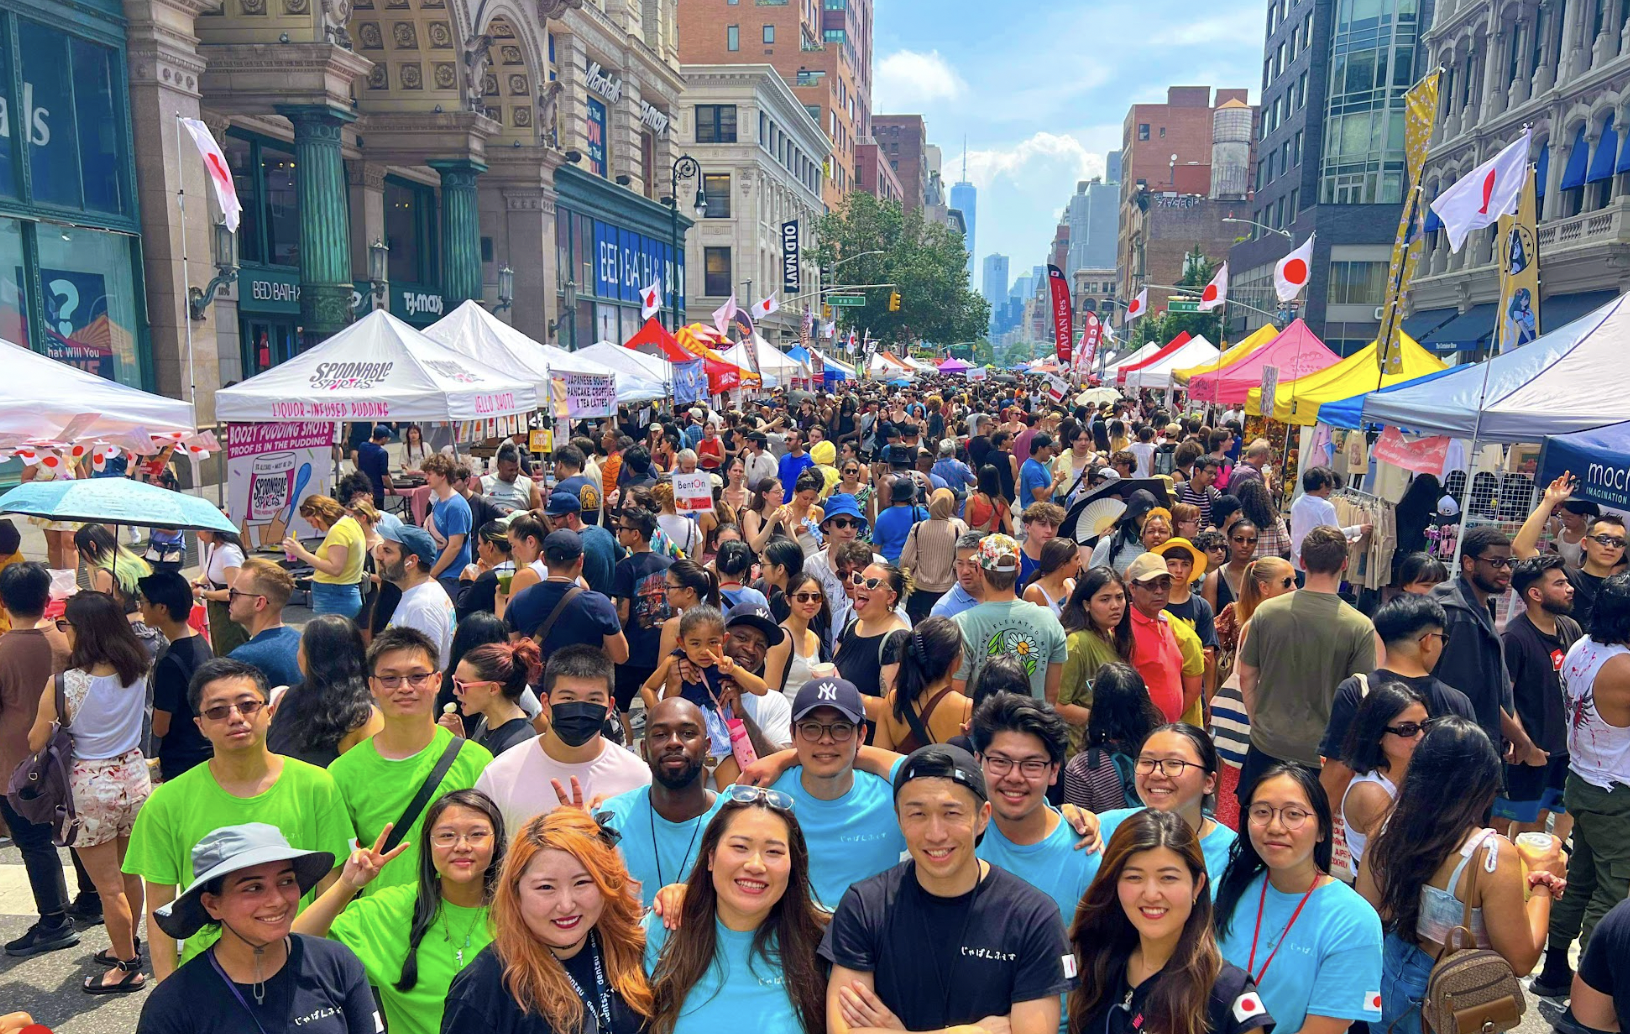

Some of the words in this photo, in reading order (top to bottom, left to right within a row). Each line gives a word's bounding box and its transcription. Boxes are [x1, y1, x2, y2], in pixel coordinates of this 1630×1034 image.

[585, 62, 622, 104] Marshalls
[784, 225, 797, 252] OLD
[600, 241, 623, 284] BED
[785, 254, 798, 289] NAVY
[253, 281, 272, 299] BED
[273, 283, 296, 301] BATH
[1058, 299, 1067, 316] Fes
[1058, 318, 1070, 352] JAPAN
[48, 347, 63, 358] hat
[65, 347, 82, 358] Will
[84, 348, 100, 358] You
[568, 375, 592, 386] JAPANESE
[351, 402, 389, 417] PUDDING
[475, 395, 494, 413] JELLO
[495, 392, 515, 411] SHOTS
[581, 399, 590, 408] TEA
[591, 398, 608, 408] LATTES
[229, 425, 260, 445] BOOZY
[260, 422, 300, 441] PUDDING
[301, 420, 330, 437] SHOTS
[255, 443, 262, 452] IS
[263, 442, 272, 451] IN
[274, 440, 288, 450] THE
[1585, 486, 1628, 504] IMAGINATION
[992, 618, 1039, 636] ELEVATED
[817, 682, 838, 700] NY
[961, 946, 1017, 961] じゃぱんふぇす
